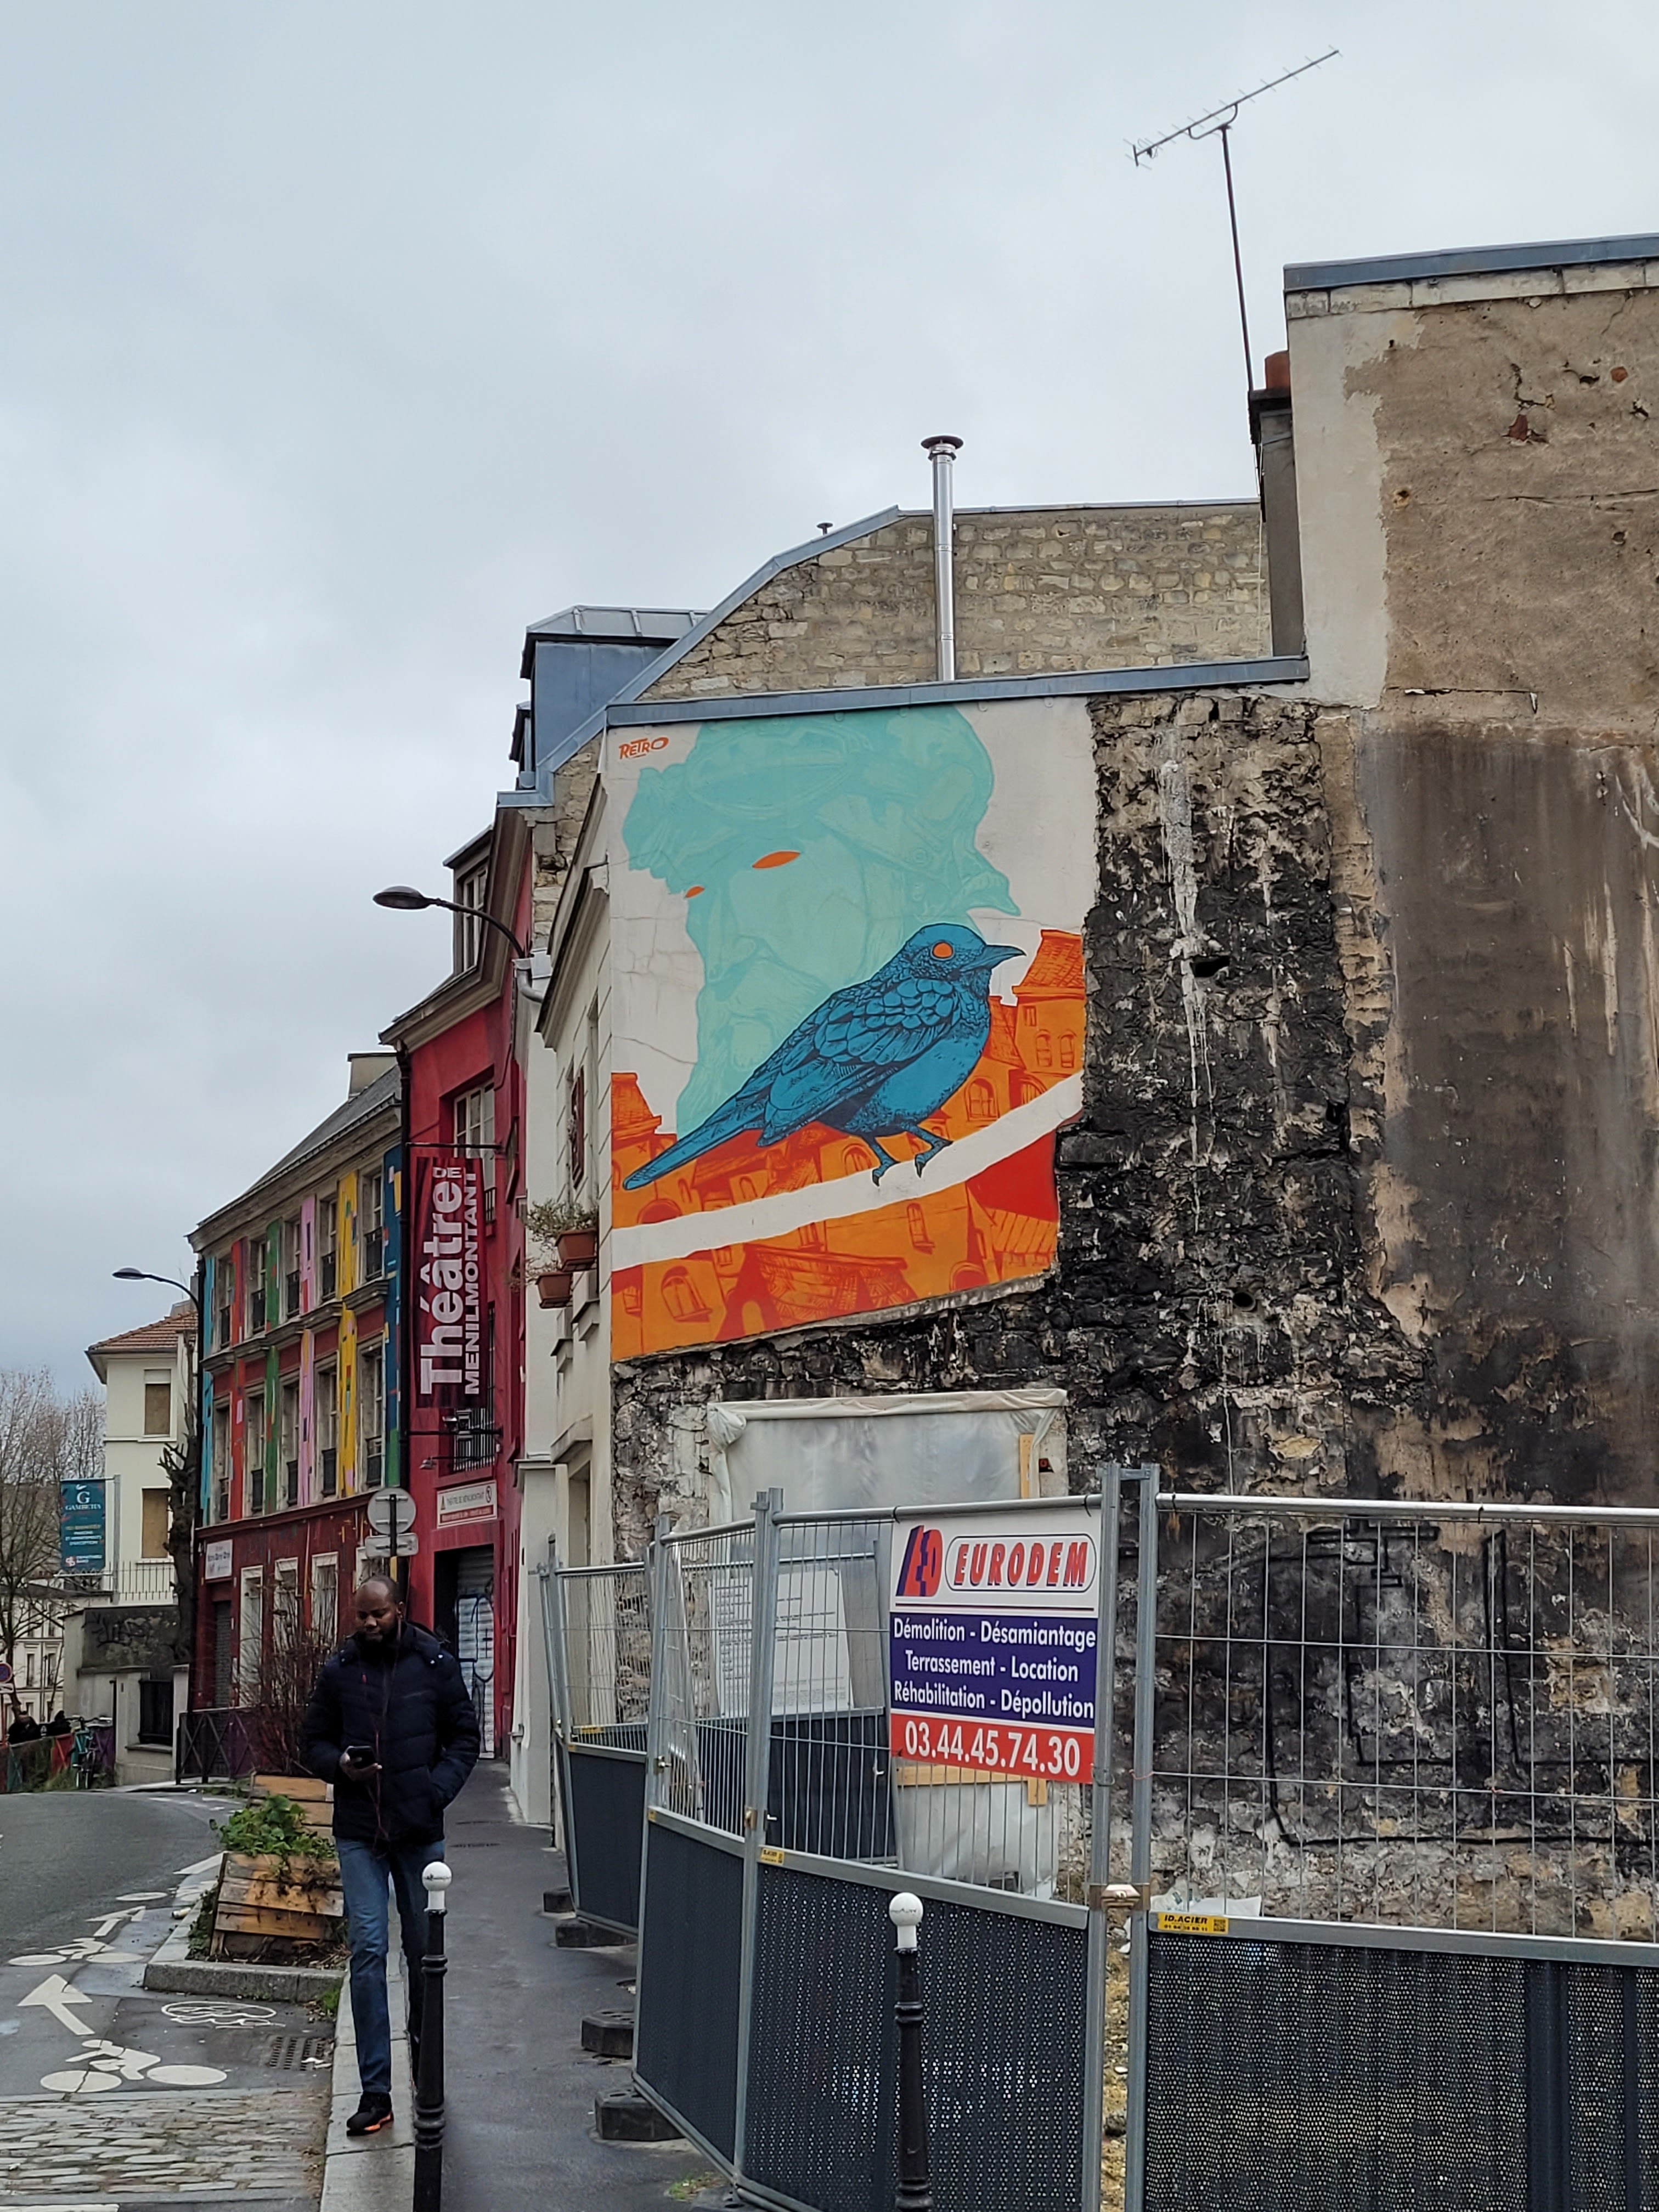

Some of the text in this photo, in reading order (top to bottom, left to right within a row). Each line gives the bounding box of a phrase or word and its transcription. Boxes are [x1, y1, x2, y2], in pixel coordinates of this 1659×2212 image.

[618, 737, 669, 759] RETRO
[433, 1167, 461, 1178] DE
[420, 1181, 463, 1395] Théâtre
[464, 1167, 479, 1395] MENILMONTANT
[953, 1542, 1088, 1587] EURODEM
[894, 1617, 965, 1641] Démolition
[980, 1621, 1096, 1652] Désamiantage
[905, 1650, 996, 1677] Terrassement
[1011, 1656, 1079, 1681] Location
[894, 1680, 985, 1709] Réhabilitation
[1001, 1689, 1094, 1719] Dépollution
[905, 1720, 1080, 1776] 03.44.45.74.30
[1164, 1915, 1208, 1924] ID.ACIER
